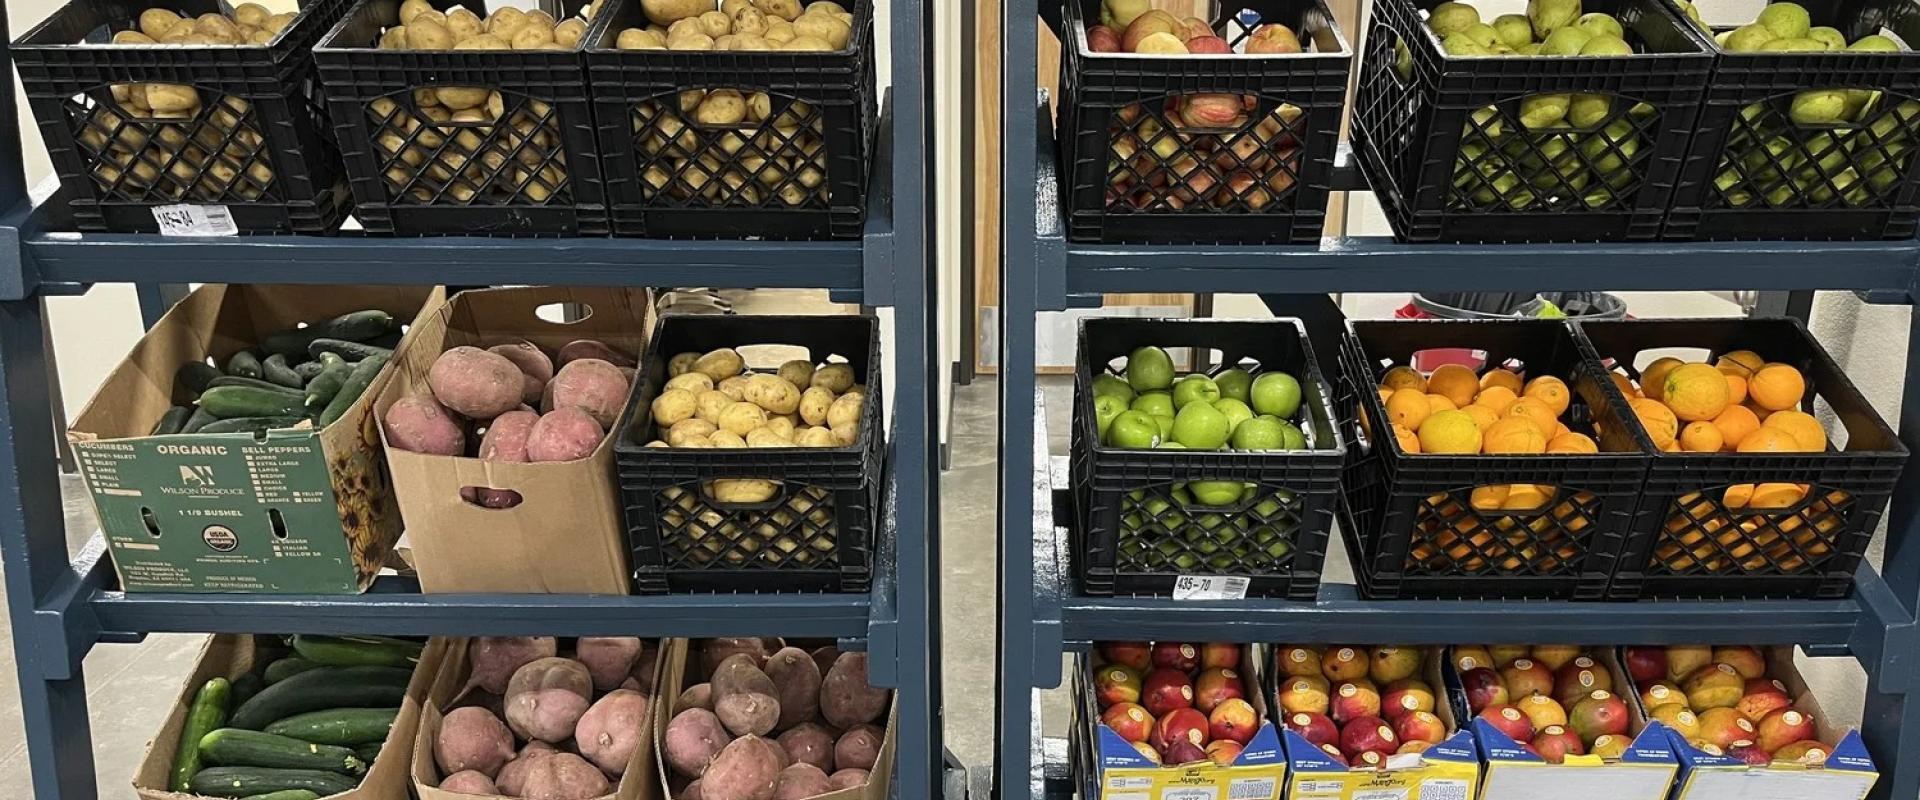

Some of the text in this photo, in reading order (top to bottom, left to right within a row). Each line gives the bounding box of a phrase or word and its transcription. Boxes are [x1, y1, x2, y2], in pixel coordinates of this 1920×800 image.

[157, 445, 228, 455] ORGANIC
[160, 486, 245, 495] WILSON PRODUCE
